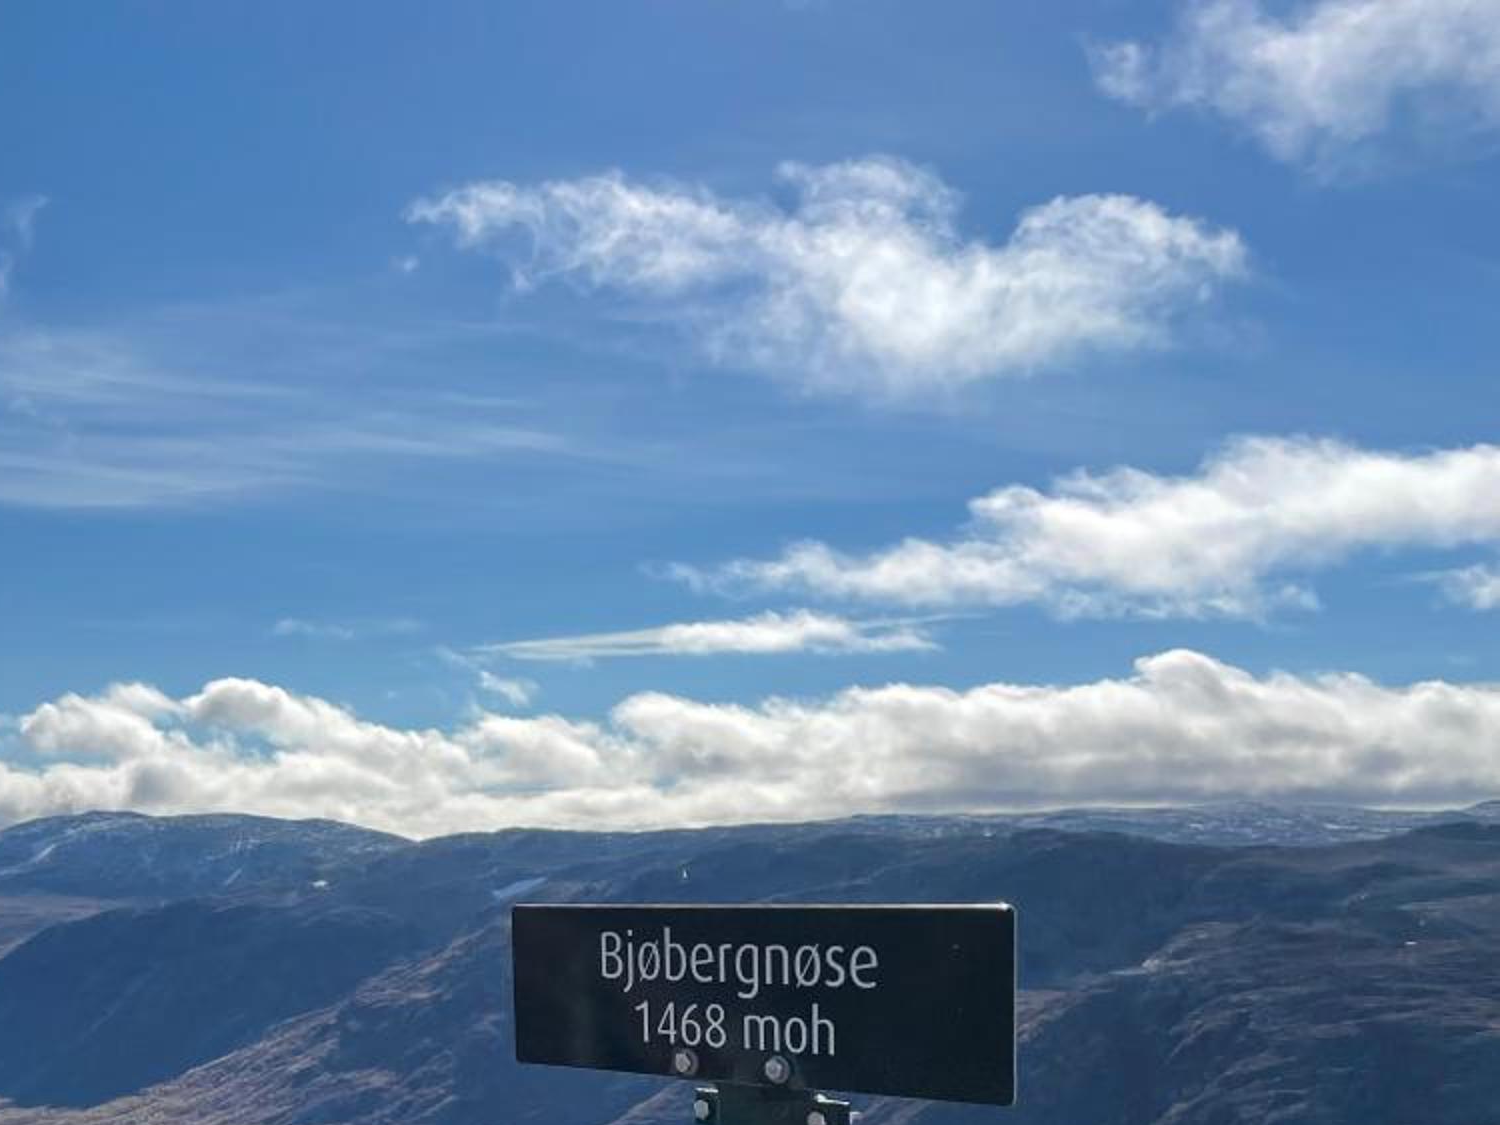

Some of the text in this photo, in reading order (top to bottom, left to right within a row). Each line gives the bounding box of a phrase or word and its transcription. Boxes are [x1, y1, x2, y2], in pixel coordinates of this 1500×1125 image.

[600, 926, 878, 999] Bjøbergnøse
[633, 1001, 836, 1056] 1468 moh
